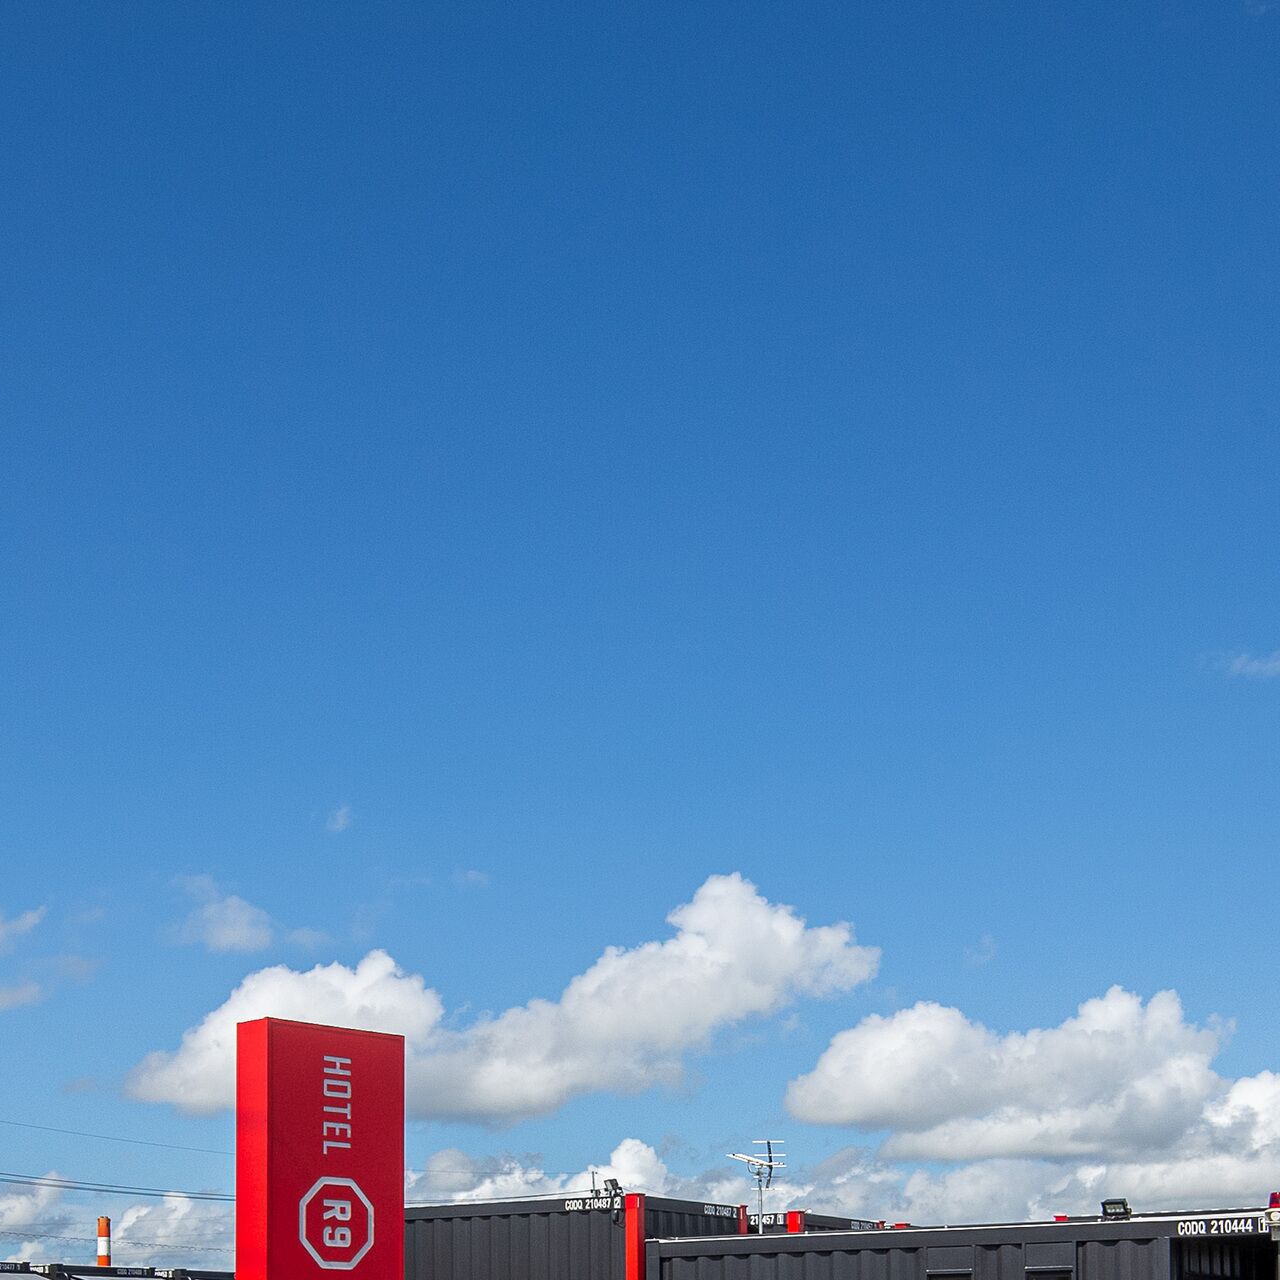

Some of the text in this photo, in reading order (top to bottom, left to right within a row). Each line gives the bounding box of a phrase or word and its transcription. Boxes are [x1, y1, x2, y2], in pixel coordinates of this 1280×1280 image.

[322, 1054, 352, 1156] HOTEL
[565, 1199, 583, 1211] CODQ
[585, 1197, 611, 1210] 210487
[322, 1198, 352, 1248] R9
[750, 1214, 775, 1226] 21457
[1177, 1220, 1207, 1236] CODQ
[1210, 1218, 1254, 1234] 210444
